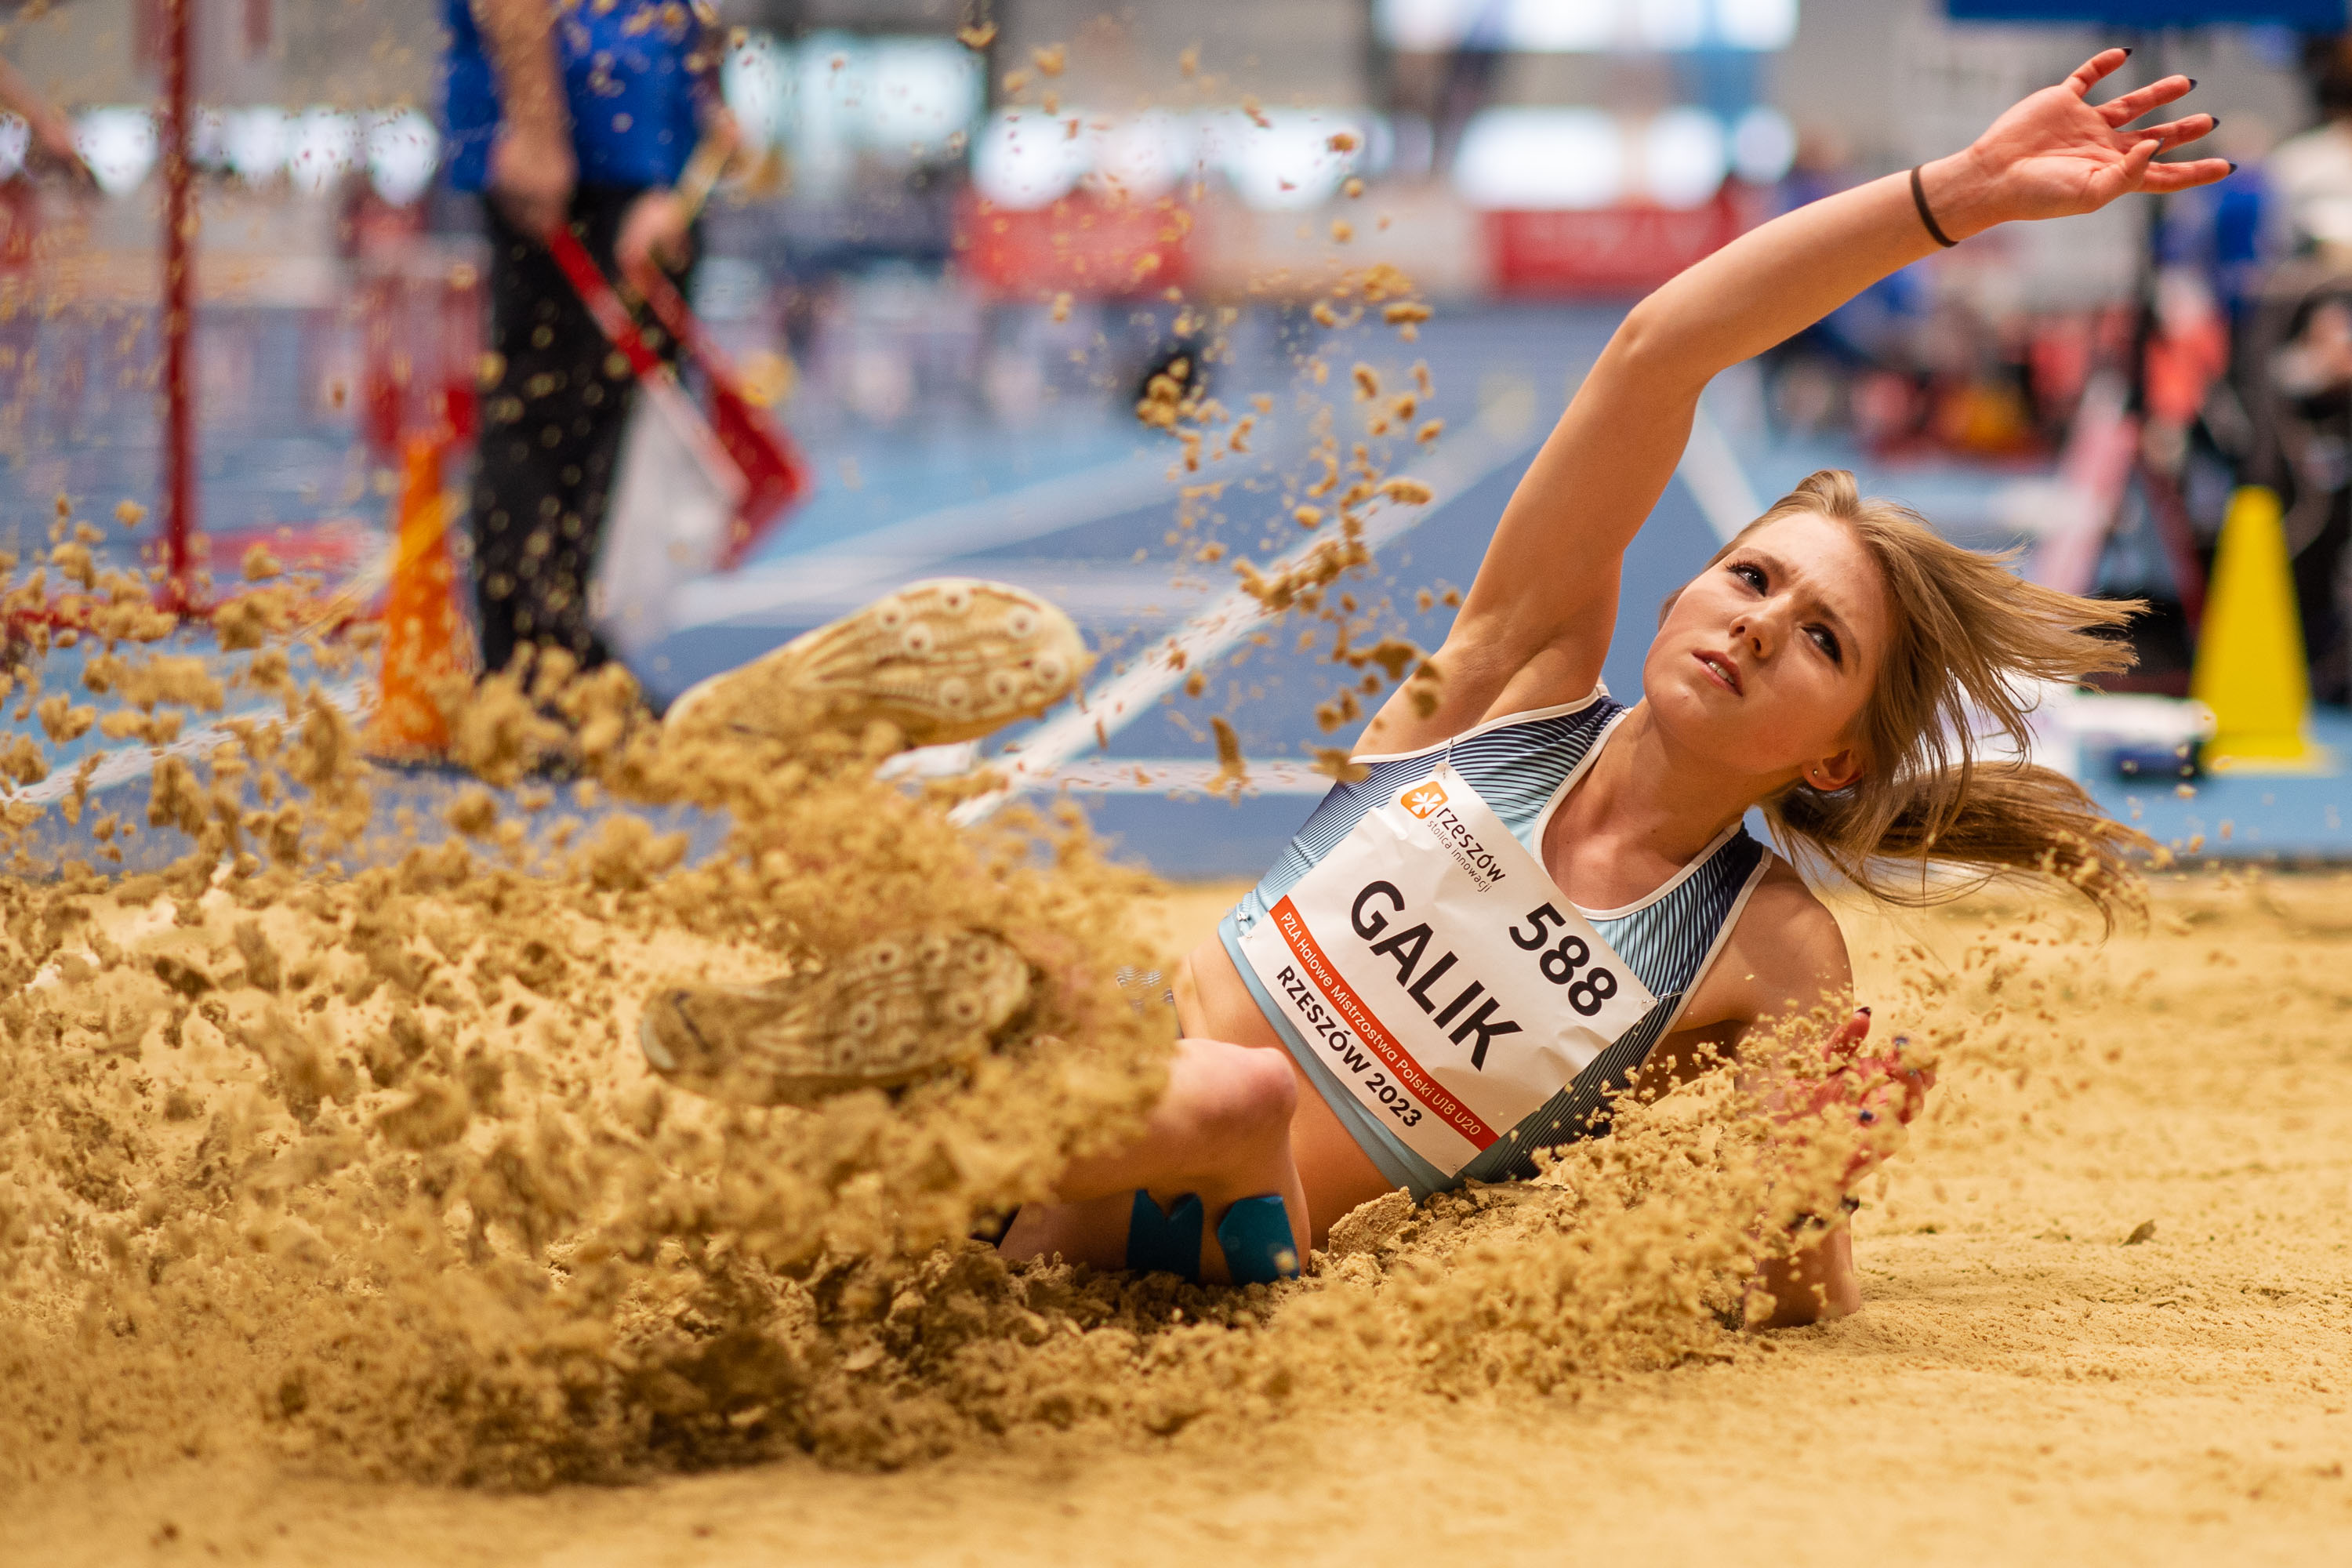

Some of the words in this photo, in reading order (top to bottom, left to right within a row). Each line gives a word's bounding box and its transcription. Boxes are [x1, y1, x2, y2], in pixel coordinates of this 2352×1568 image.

[1427, 820, 1452, 849] stolica
[1450, 848, 1493, 893] innowacji
[1436, 807, 1506, 883] rzeszów
[1280, 912, 1302, 942] PZLA
[1296, 938, 1333, 987] Halowe
[1330, 985, 1399, 1062] Mistrzostwa
[1396, 1059, 1435, 1098] Polski
[1432, 1093, 1457, 1116] U18
[1454, 1112, 1481, 1135] U20
[1351, 880, 1524, 1073] GALIK
[1508, 902, 1618, 1017] 588
[1276, 965, 1372, 1074] RZESZÓW
[1364, 1073, 1422, 1127] 2023
